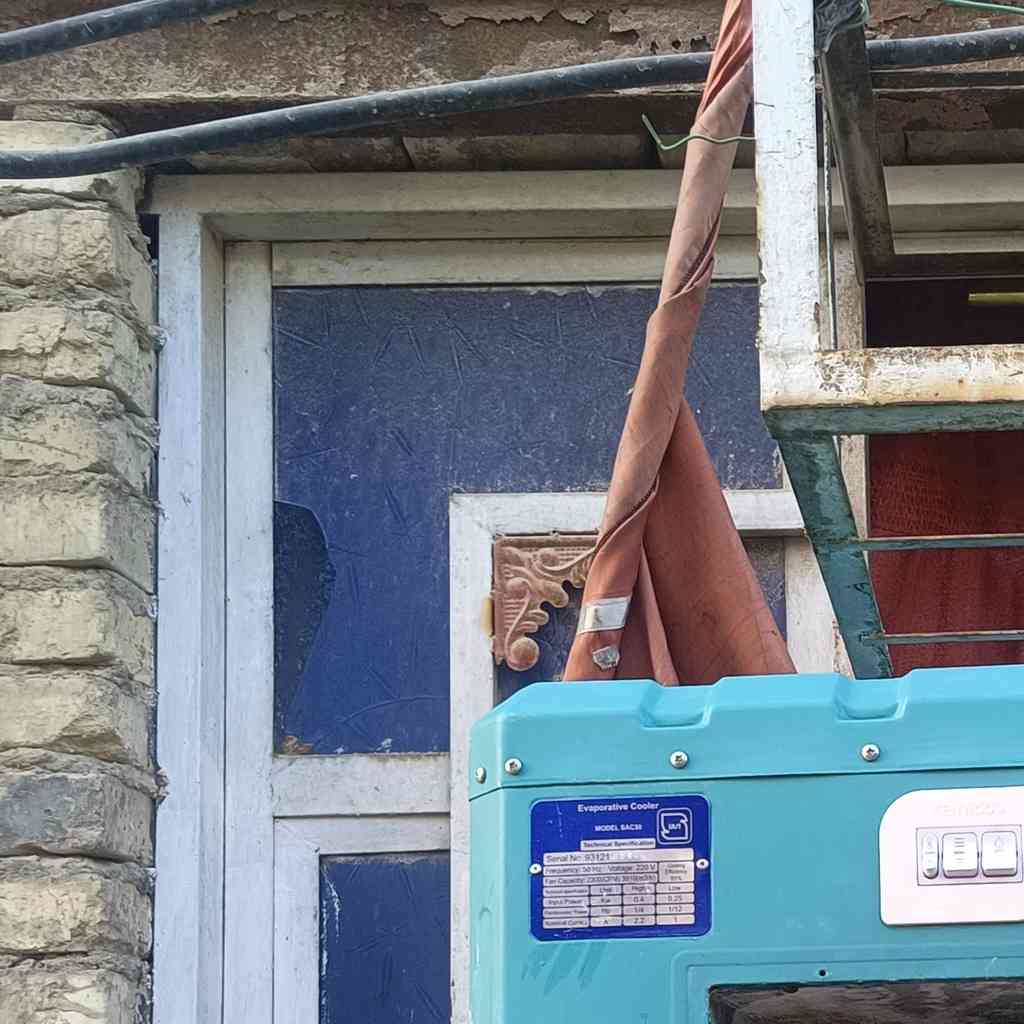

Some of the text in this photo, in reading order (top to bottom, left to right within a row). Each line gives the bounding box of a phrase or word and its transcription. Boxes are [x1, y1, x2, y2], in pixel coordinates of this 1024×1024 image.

[577, 801, 660, 814] Evaporative Cooler
[594, 824, 619, 833] MODEL
